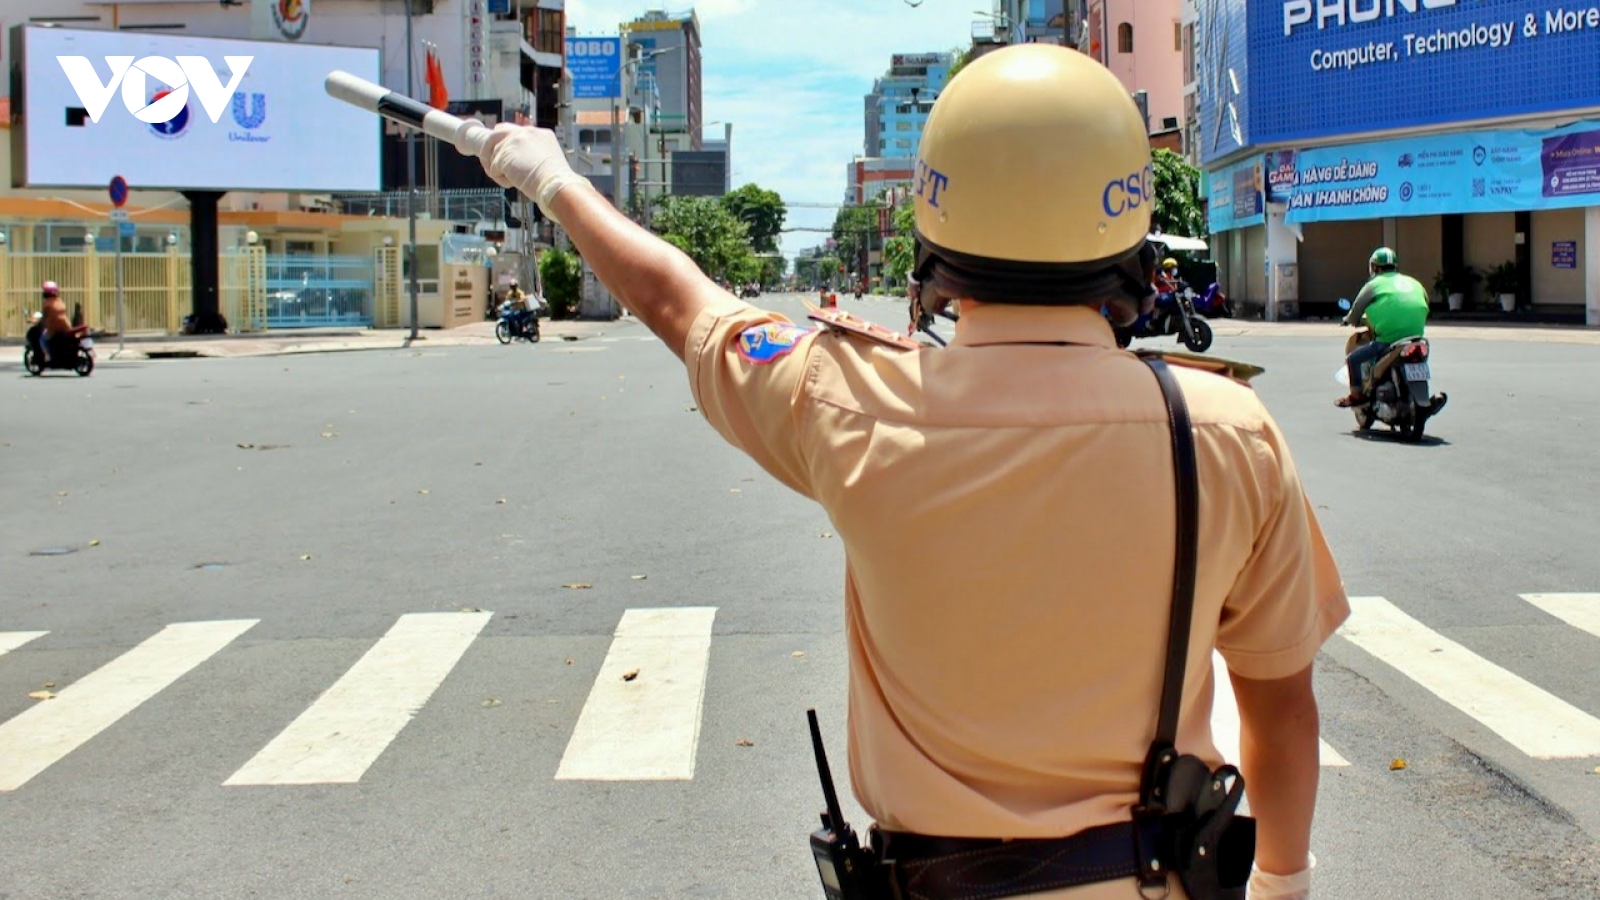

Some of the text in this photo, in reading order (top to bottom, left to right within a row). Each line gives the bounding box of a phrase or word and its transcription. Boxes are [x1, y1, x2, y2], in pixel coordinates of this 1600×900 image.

[1284, 0, 1456, 36] PHO
[565, 40, 616, 57] ROBO
[1310, 7, 1600, 71] Computer, Technology & More
